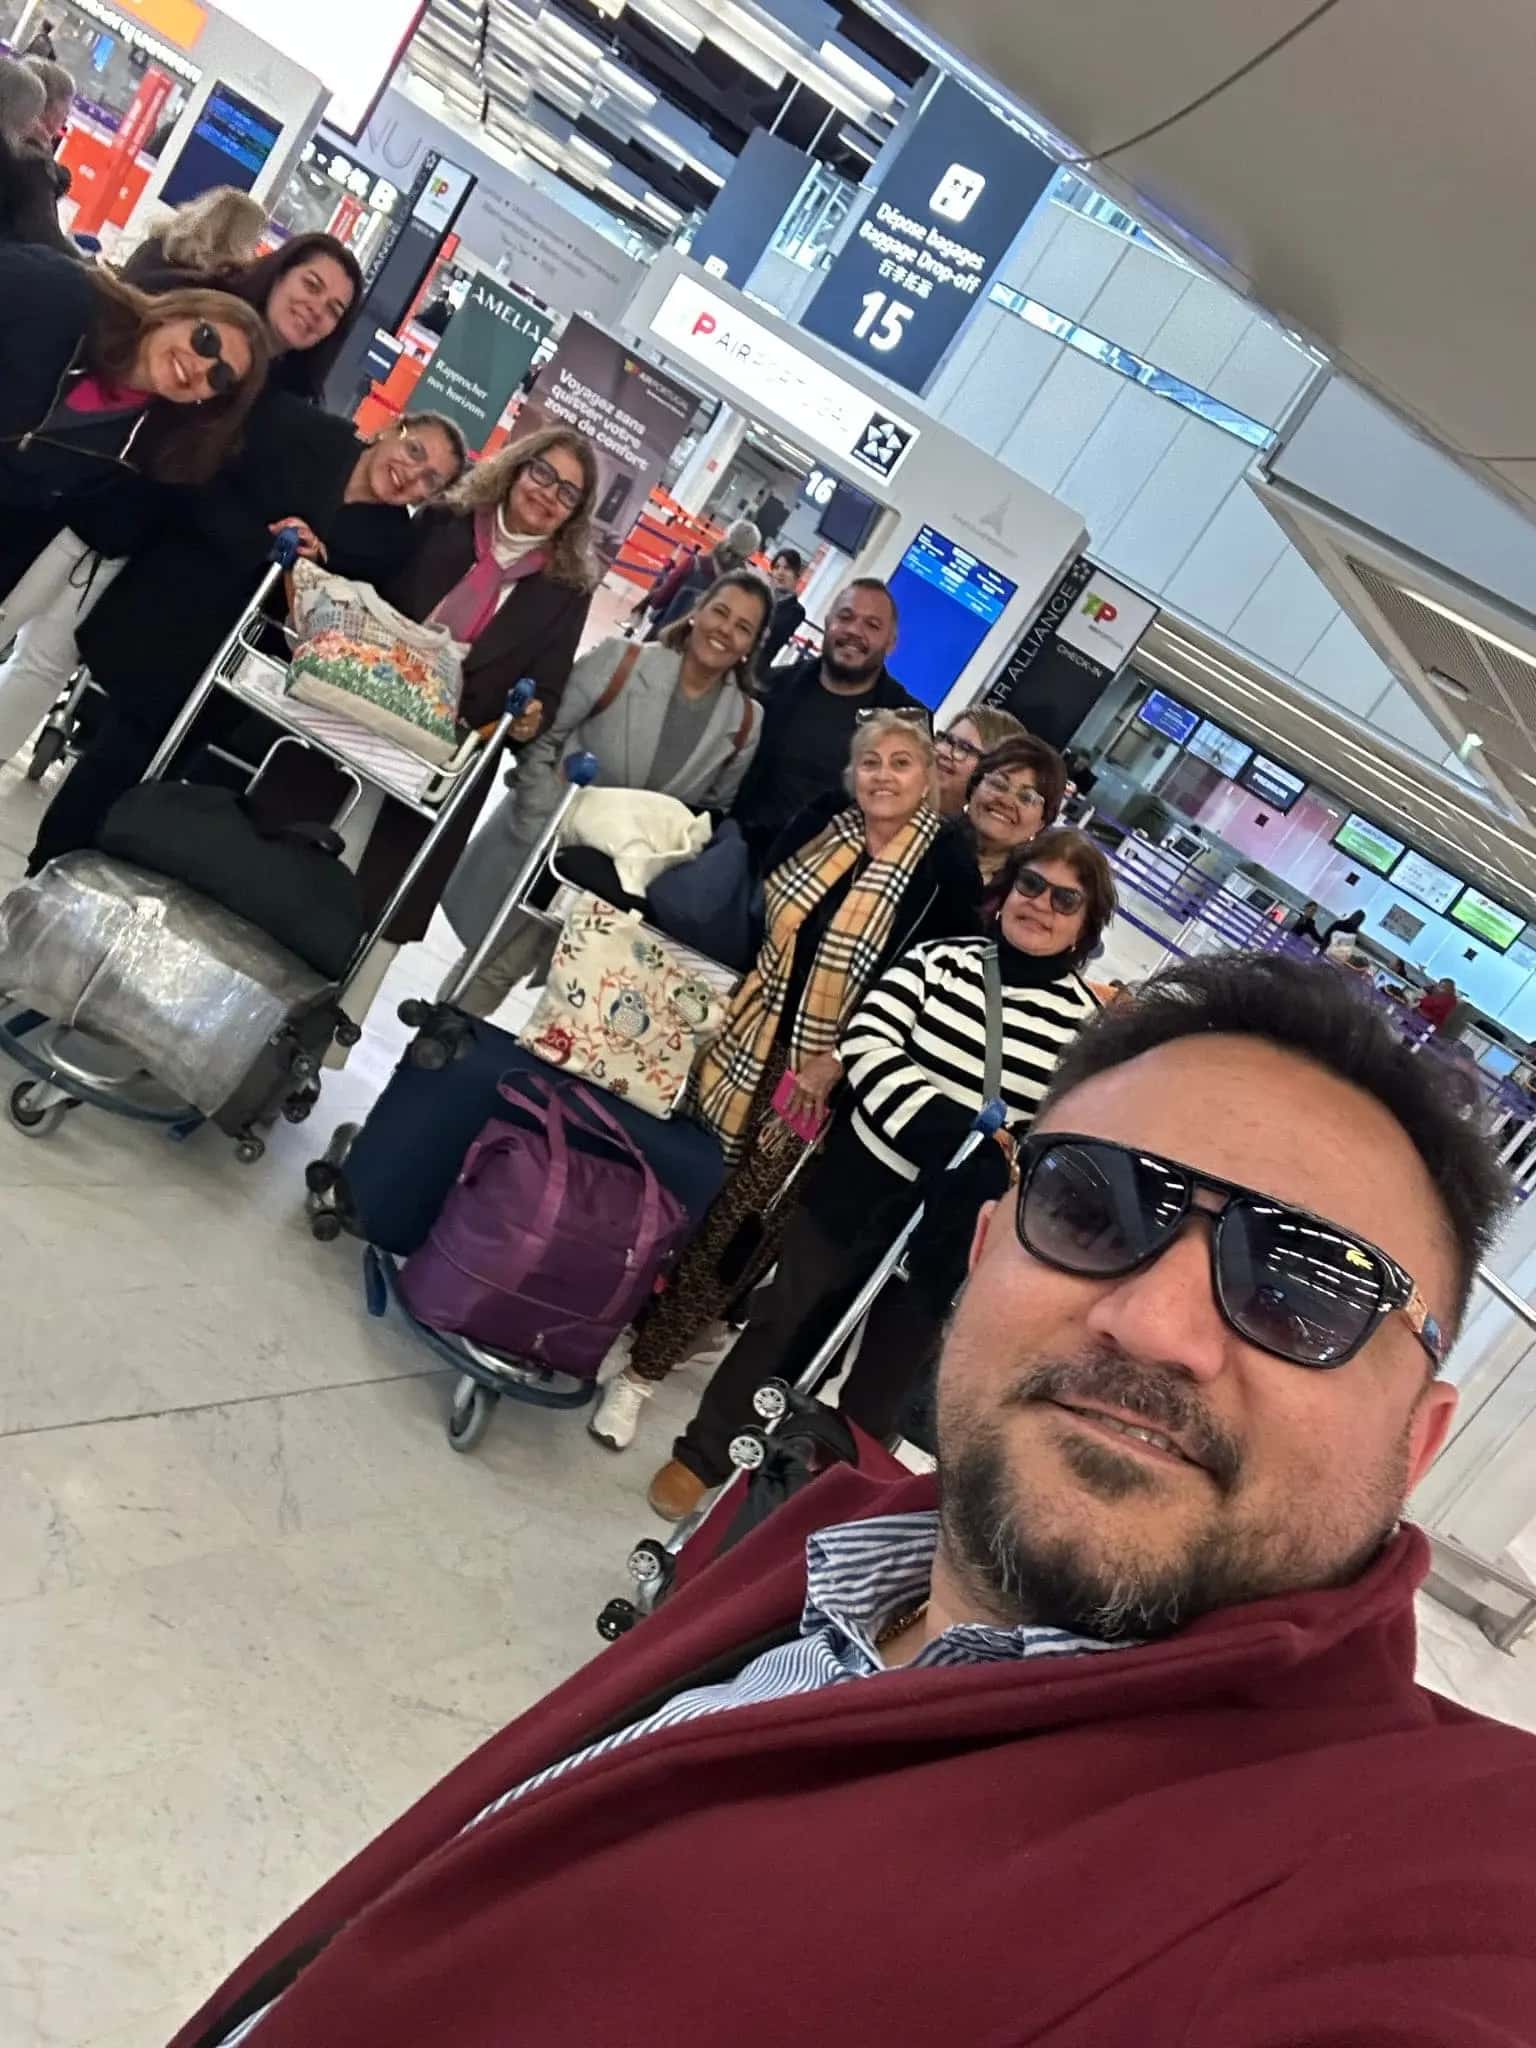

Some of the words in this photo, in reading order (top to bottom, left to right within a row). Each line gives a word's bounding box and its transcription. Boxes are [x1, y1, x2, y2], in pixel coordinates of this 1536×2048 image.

[859, 219, 918, 263] Baggage
[916, 250, 982, 294] Drop-off
[876, 202, 928, 241] Dépose
[925, 226, 986, 271] bagages
[471, 286, 541, 343] AMELIA
[852, 290, 915, 351] 15
[715, 331, 752, 362] AIR
[435, 359, 488, 400] Rapprocher
[560, 367, 616, 415] Voyagez
[614, 408, 646, 435] sans
[544, 396, 578, 425] zone
[577, 417, 596, 437] de
[595, 431, 649, 471] confort
[551, 384, 604, 422] quitter
[602, 417, 642, 449] votre
[805, 470, 837, 504] 16
[1007, 581, 1078, 682] ALLIANCE
[1056, 643, 1103, 680] CHECK-IN
